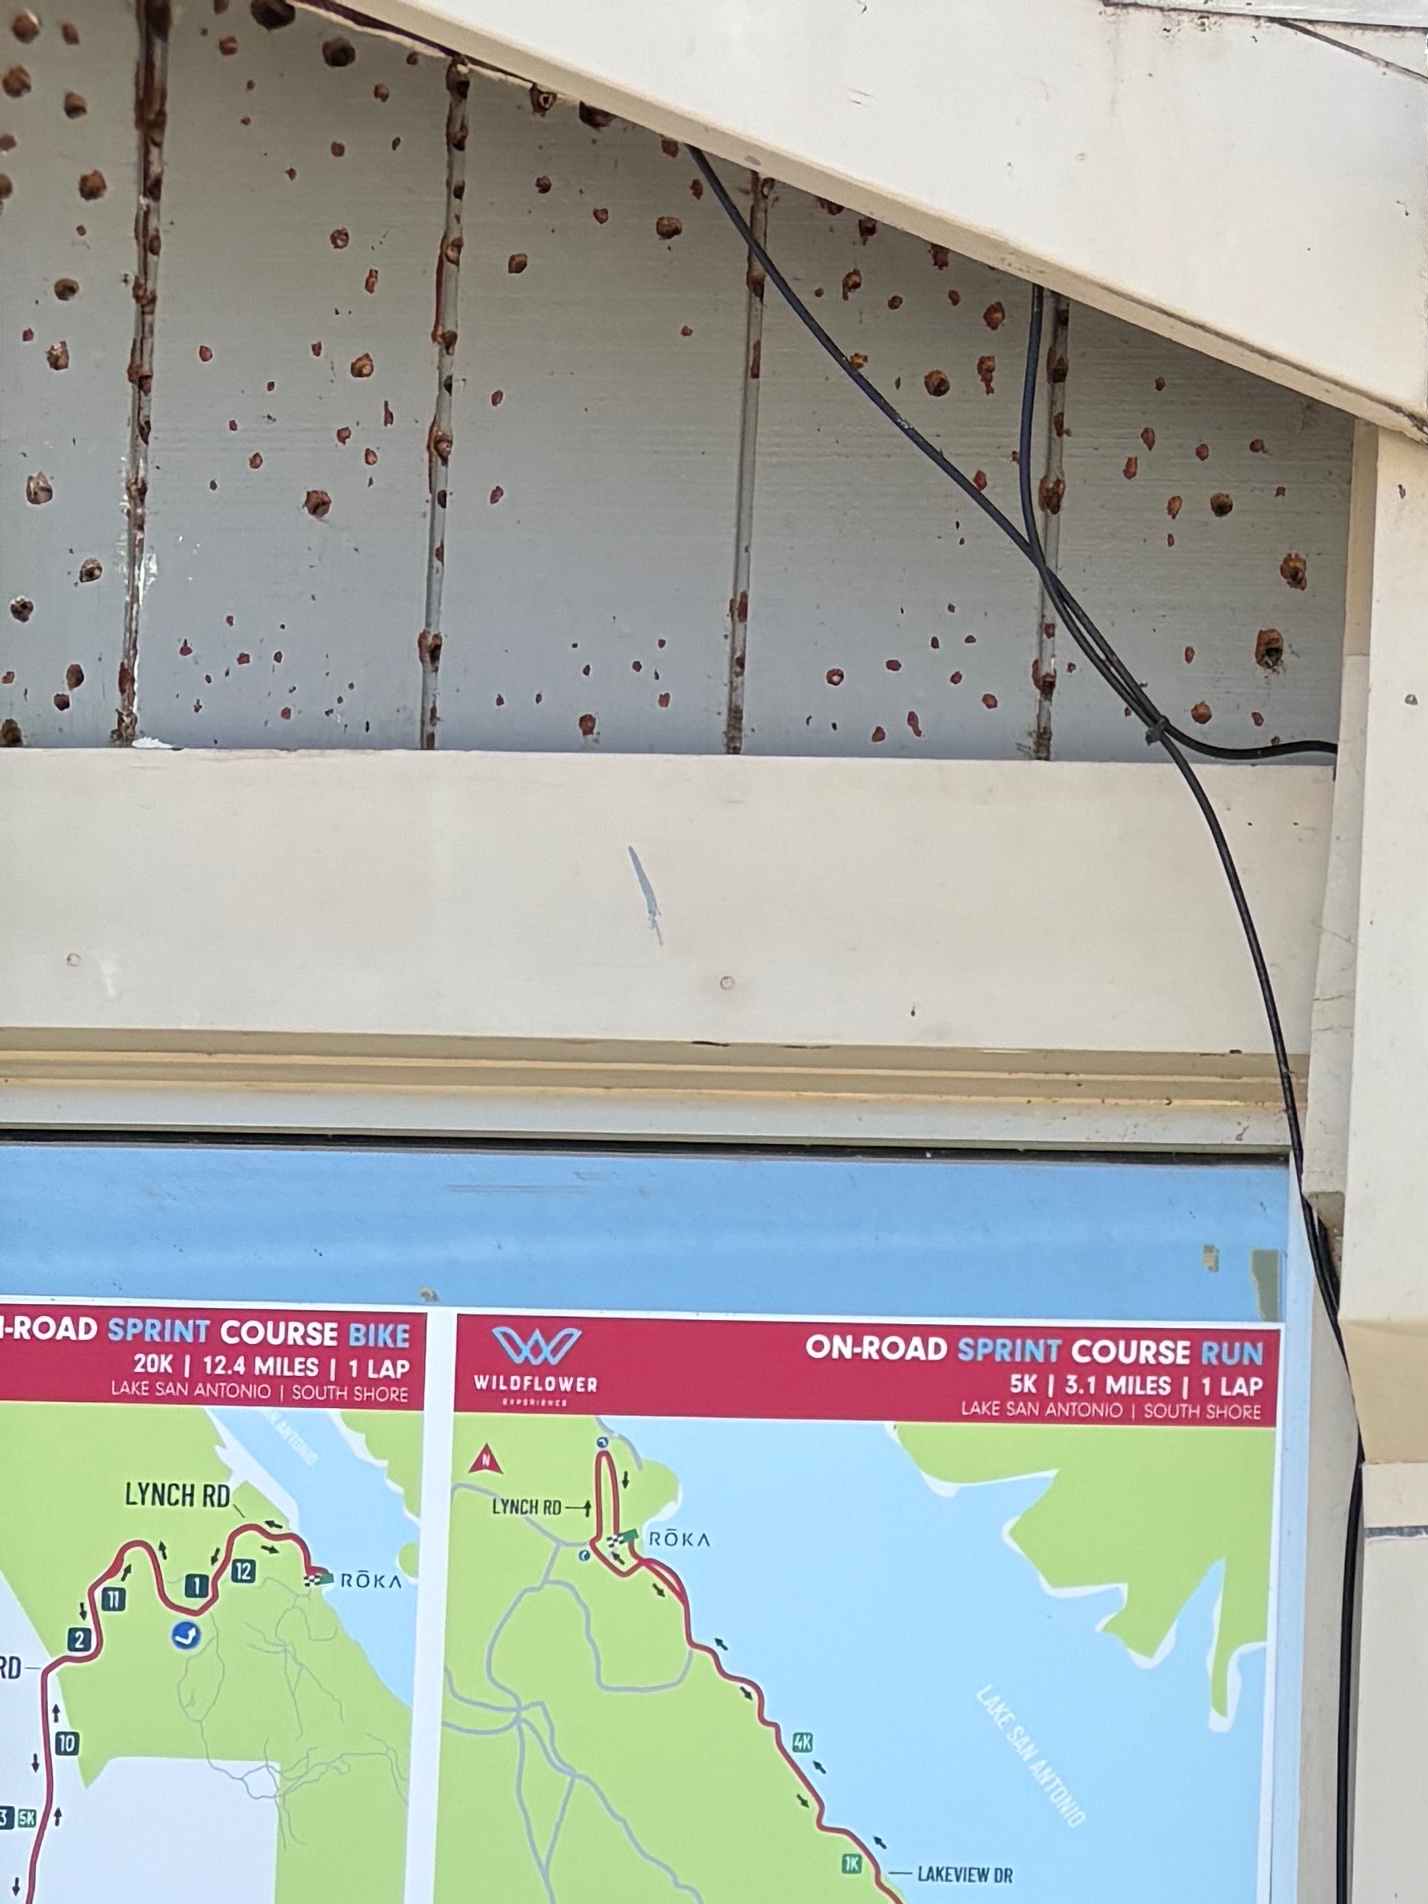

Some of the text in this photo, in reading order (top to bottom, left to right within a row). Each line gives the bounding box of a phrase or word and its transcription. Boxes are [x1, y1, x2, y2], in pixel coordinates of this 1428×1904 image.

[0, 1316, 409, 1347] -ROAD SPRINT COURSE BIKE
[806, 1334, 1263, 1365] ON-ROAD SPRINT COURSE RUN
[134, 1354, 409, 1378] 20K 12.4 MILES 1 LAP
[112, 1381, 408, 1402] LAKE SAN ANTONIO SOUTH SHORE
[474, 1375, 597, 1392] WILDFLOWER
[1011, 1374, 1263, 1396] 5K 3.1 MILES 1 LAP
[962, 1401, 1261, 1419] LAKE SAN ANTONIO SOUTH SHORE
[126, 1482, 229, 1507] LYNCH RD
[918, 1866, 1013, 1883] LAKEVIEW DR
